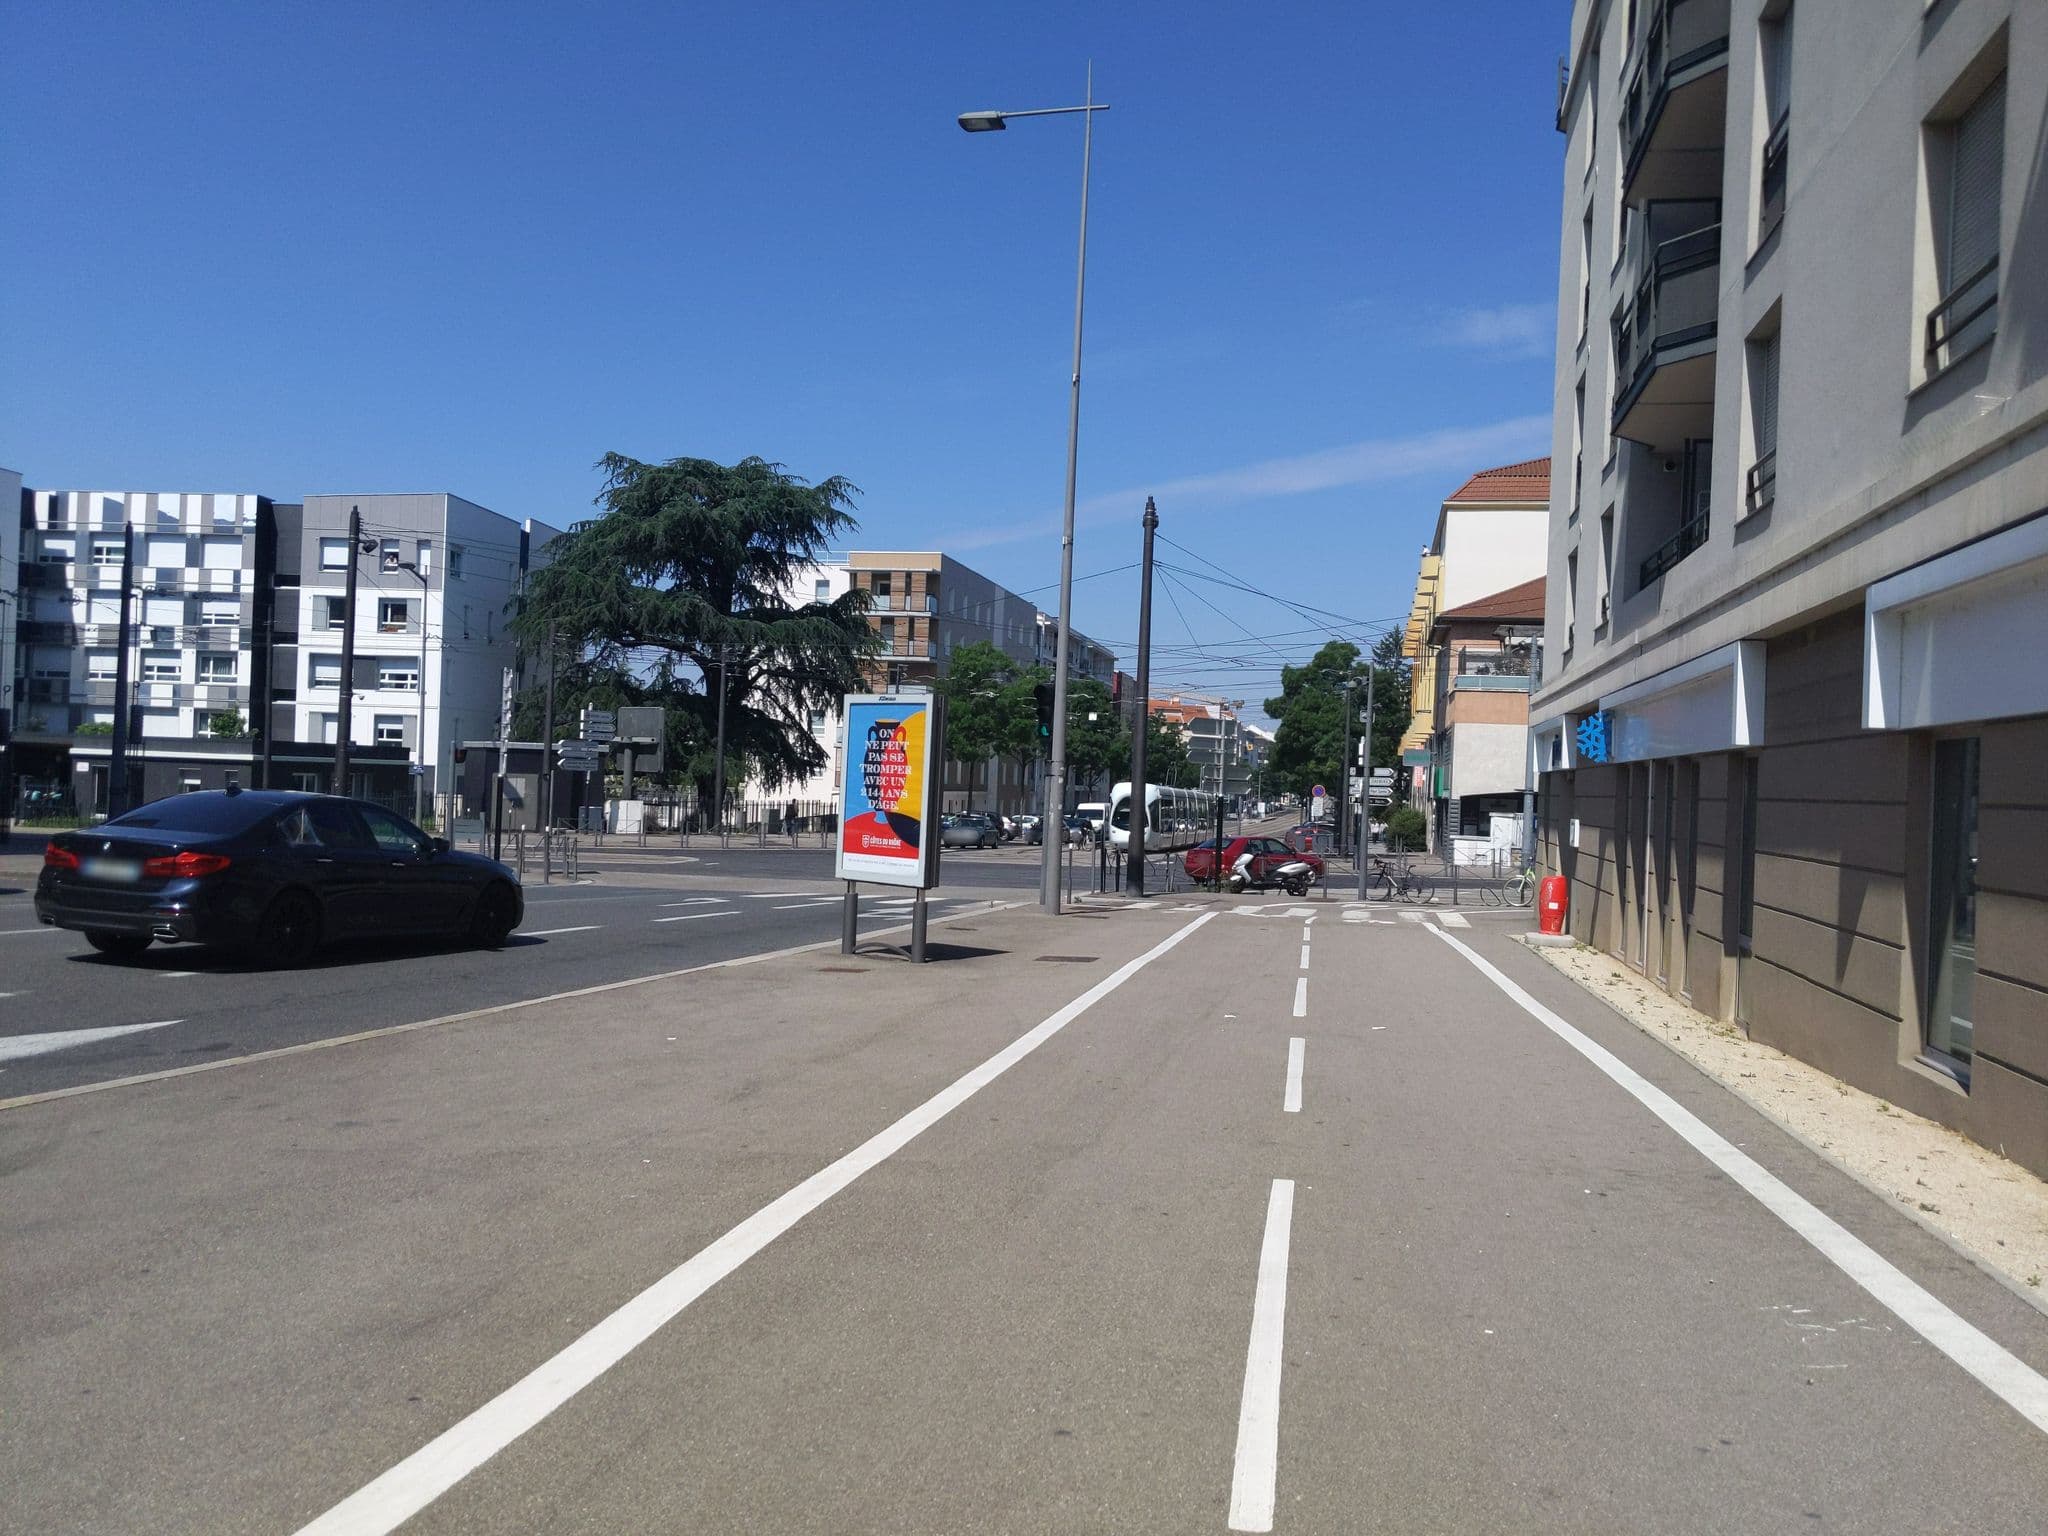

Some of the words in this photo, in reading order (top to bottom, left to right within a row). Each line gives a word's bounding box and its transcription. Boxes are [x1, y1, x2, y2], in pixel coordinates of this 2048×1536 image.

[879, 729, 895, 738] ON
[865, 740, 879, 750] NE
[881, 741, 910, 751] PEUT
[868, 752, 888, 762] PAS
[889, 753, 905, 763] SE
[859, 763, 912, 775] TROMPER
[863, 776, 889, 786] AVEC
[891, 777, 906, 786] UN
[885, 788, 908, 799] ANS
